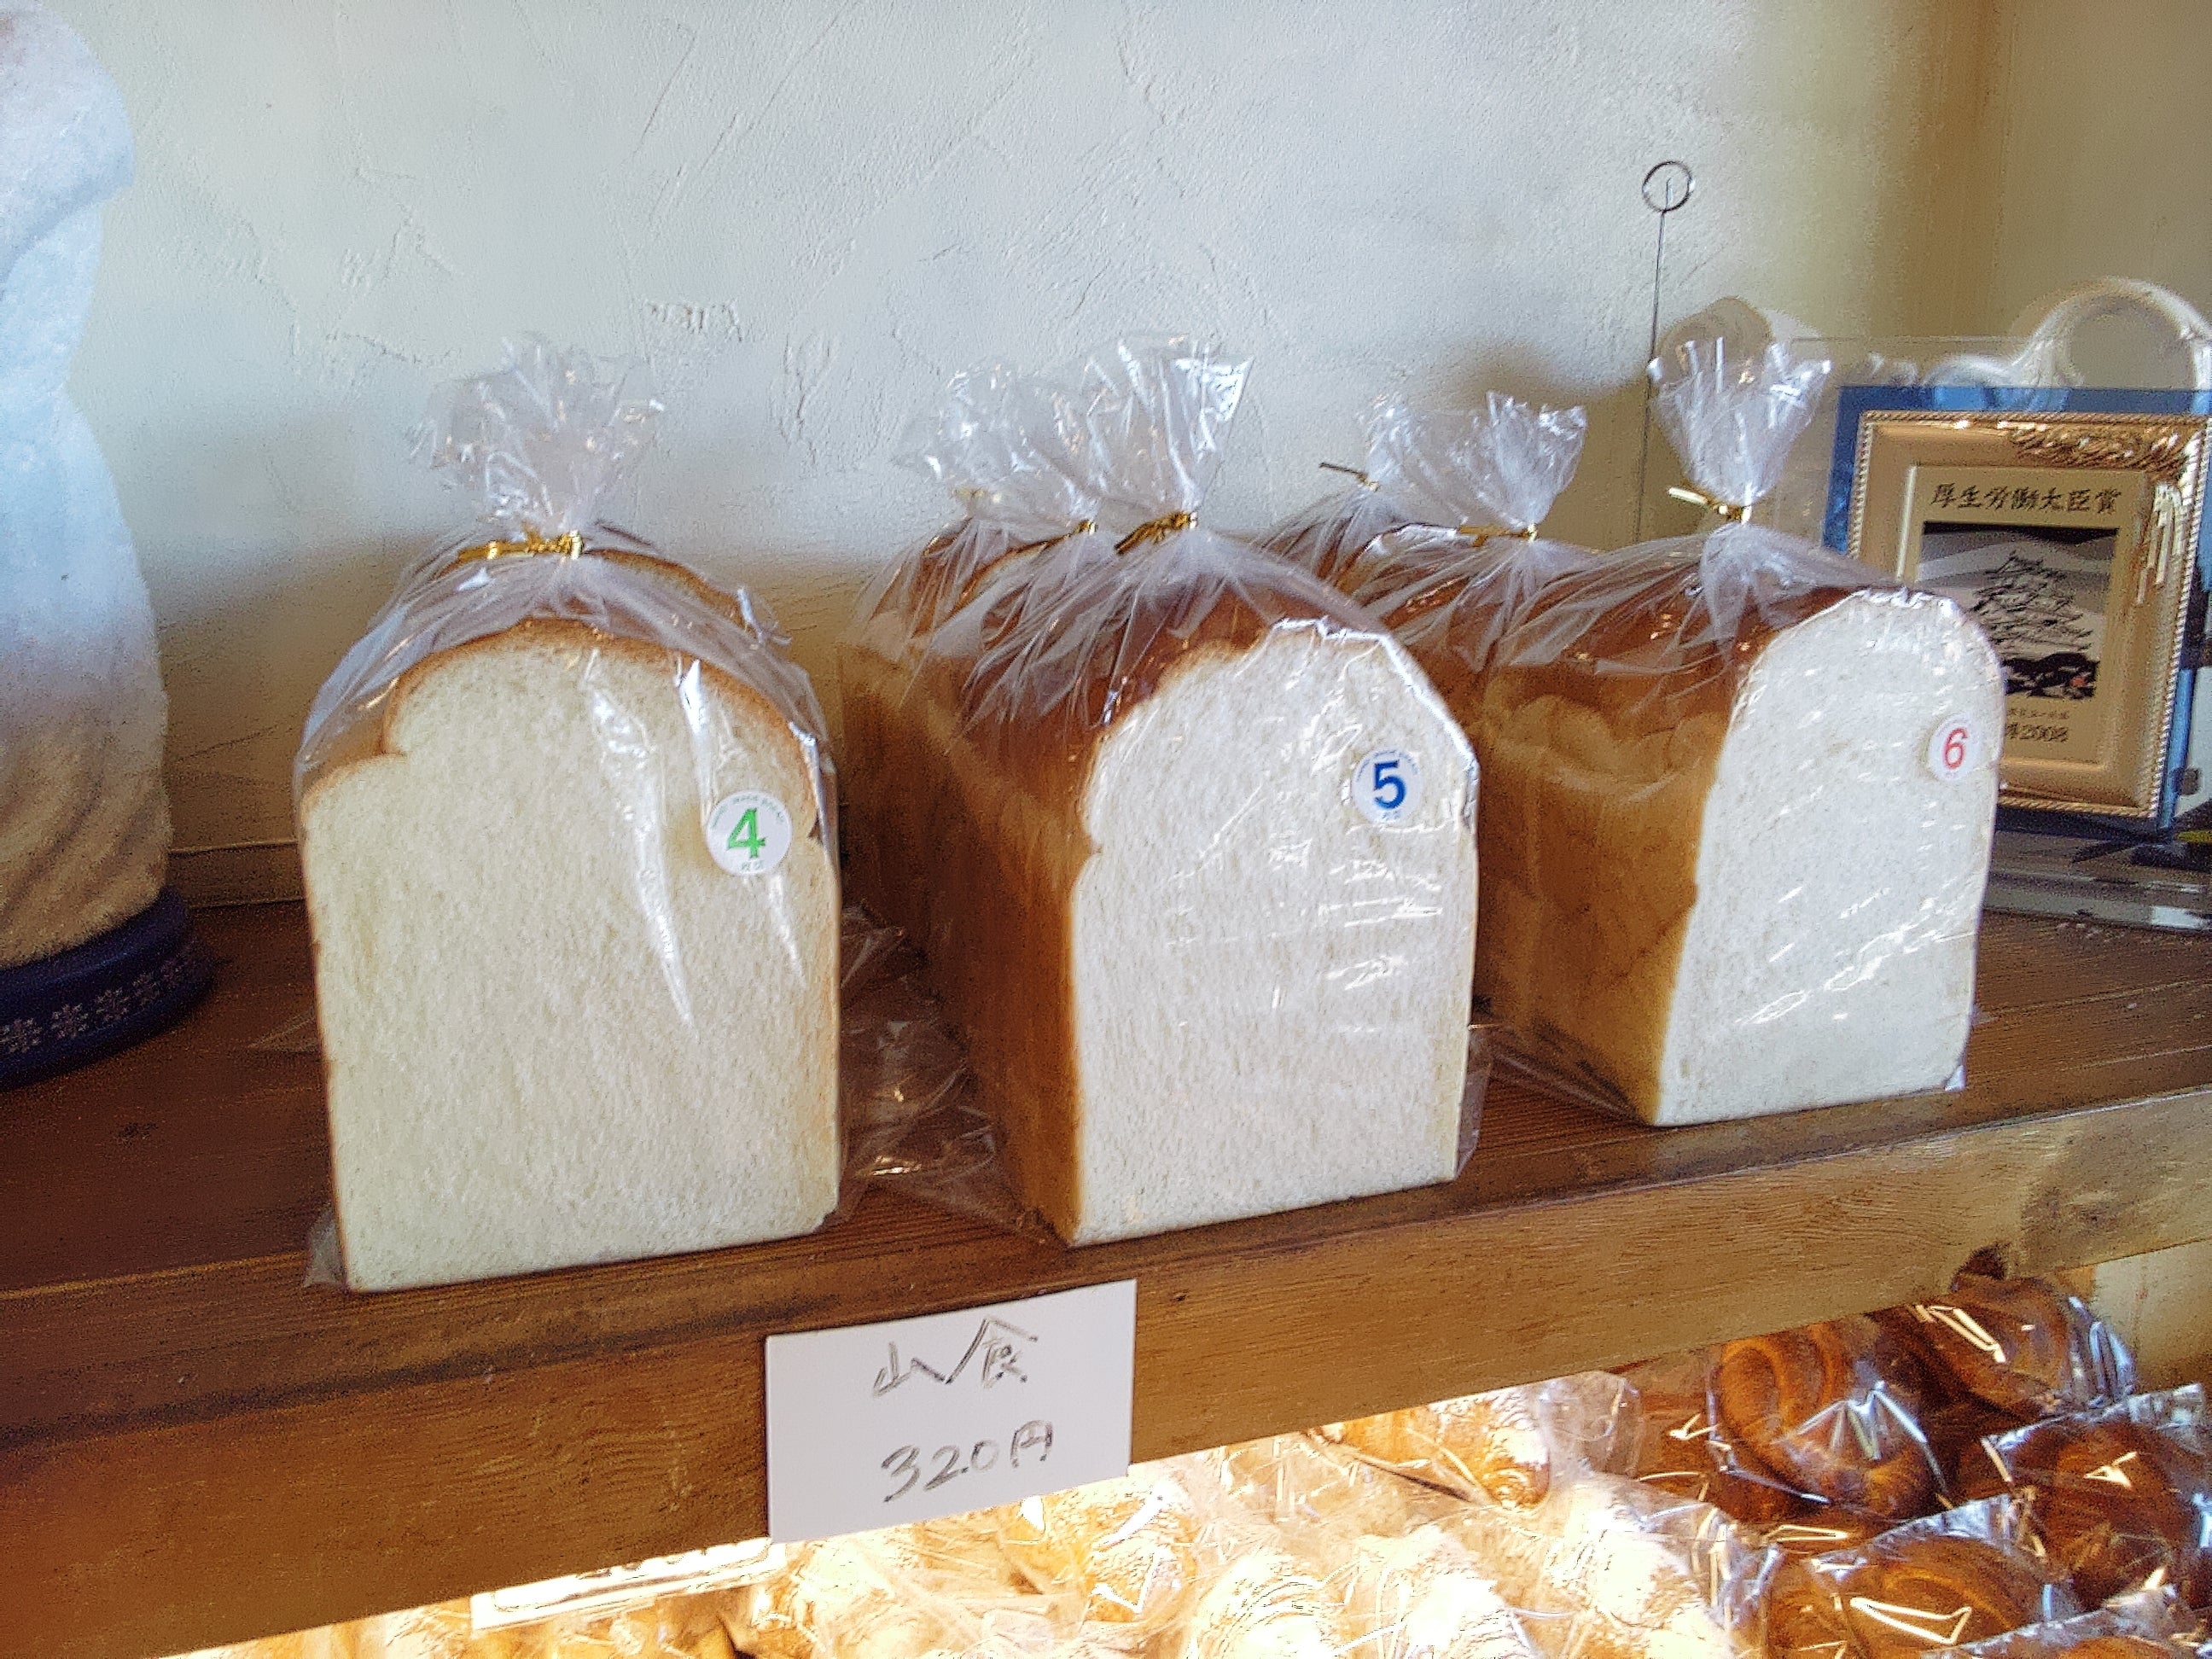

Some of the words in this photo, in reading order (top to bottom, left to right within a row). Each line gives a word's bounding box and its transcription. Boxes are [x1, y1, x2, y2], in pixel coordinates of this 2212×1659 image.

[1943, 727, 1969, 770] 6
[1373, 759, 1406, 809] 5
[726, 807, 766, 859] 4
[881, 1419, 1054, 1502] 320円
